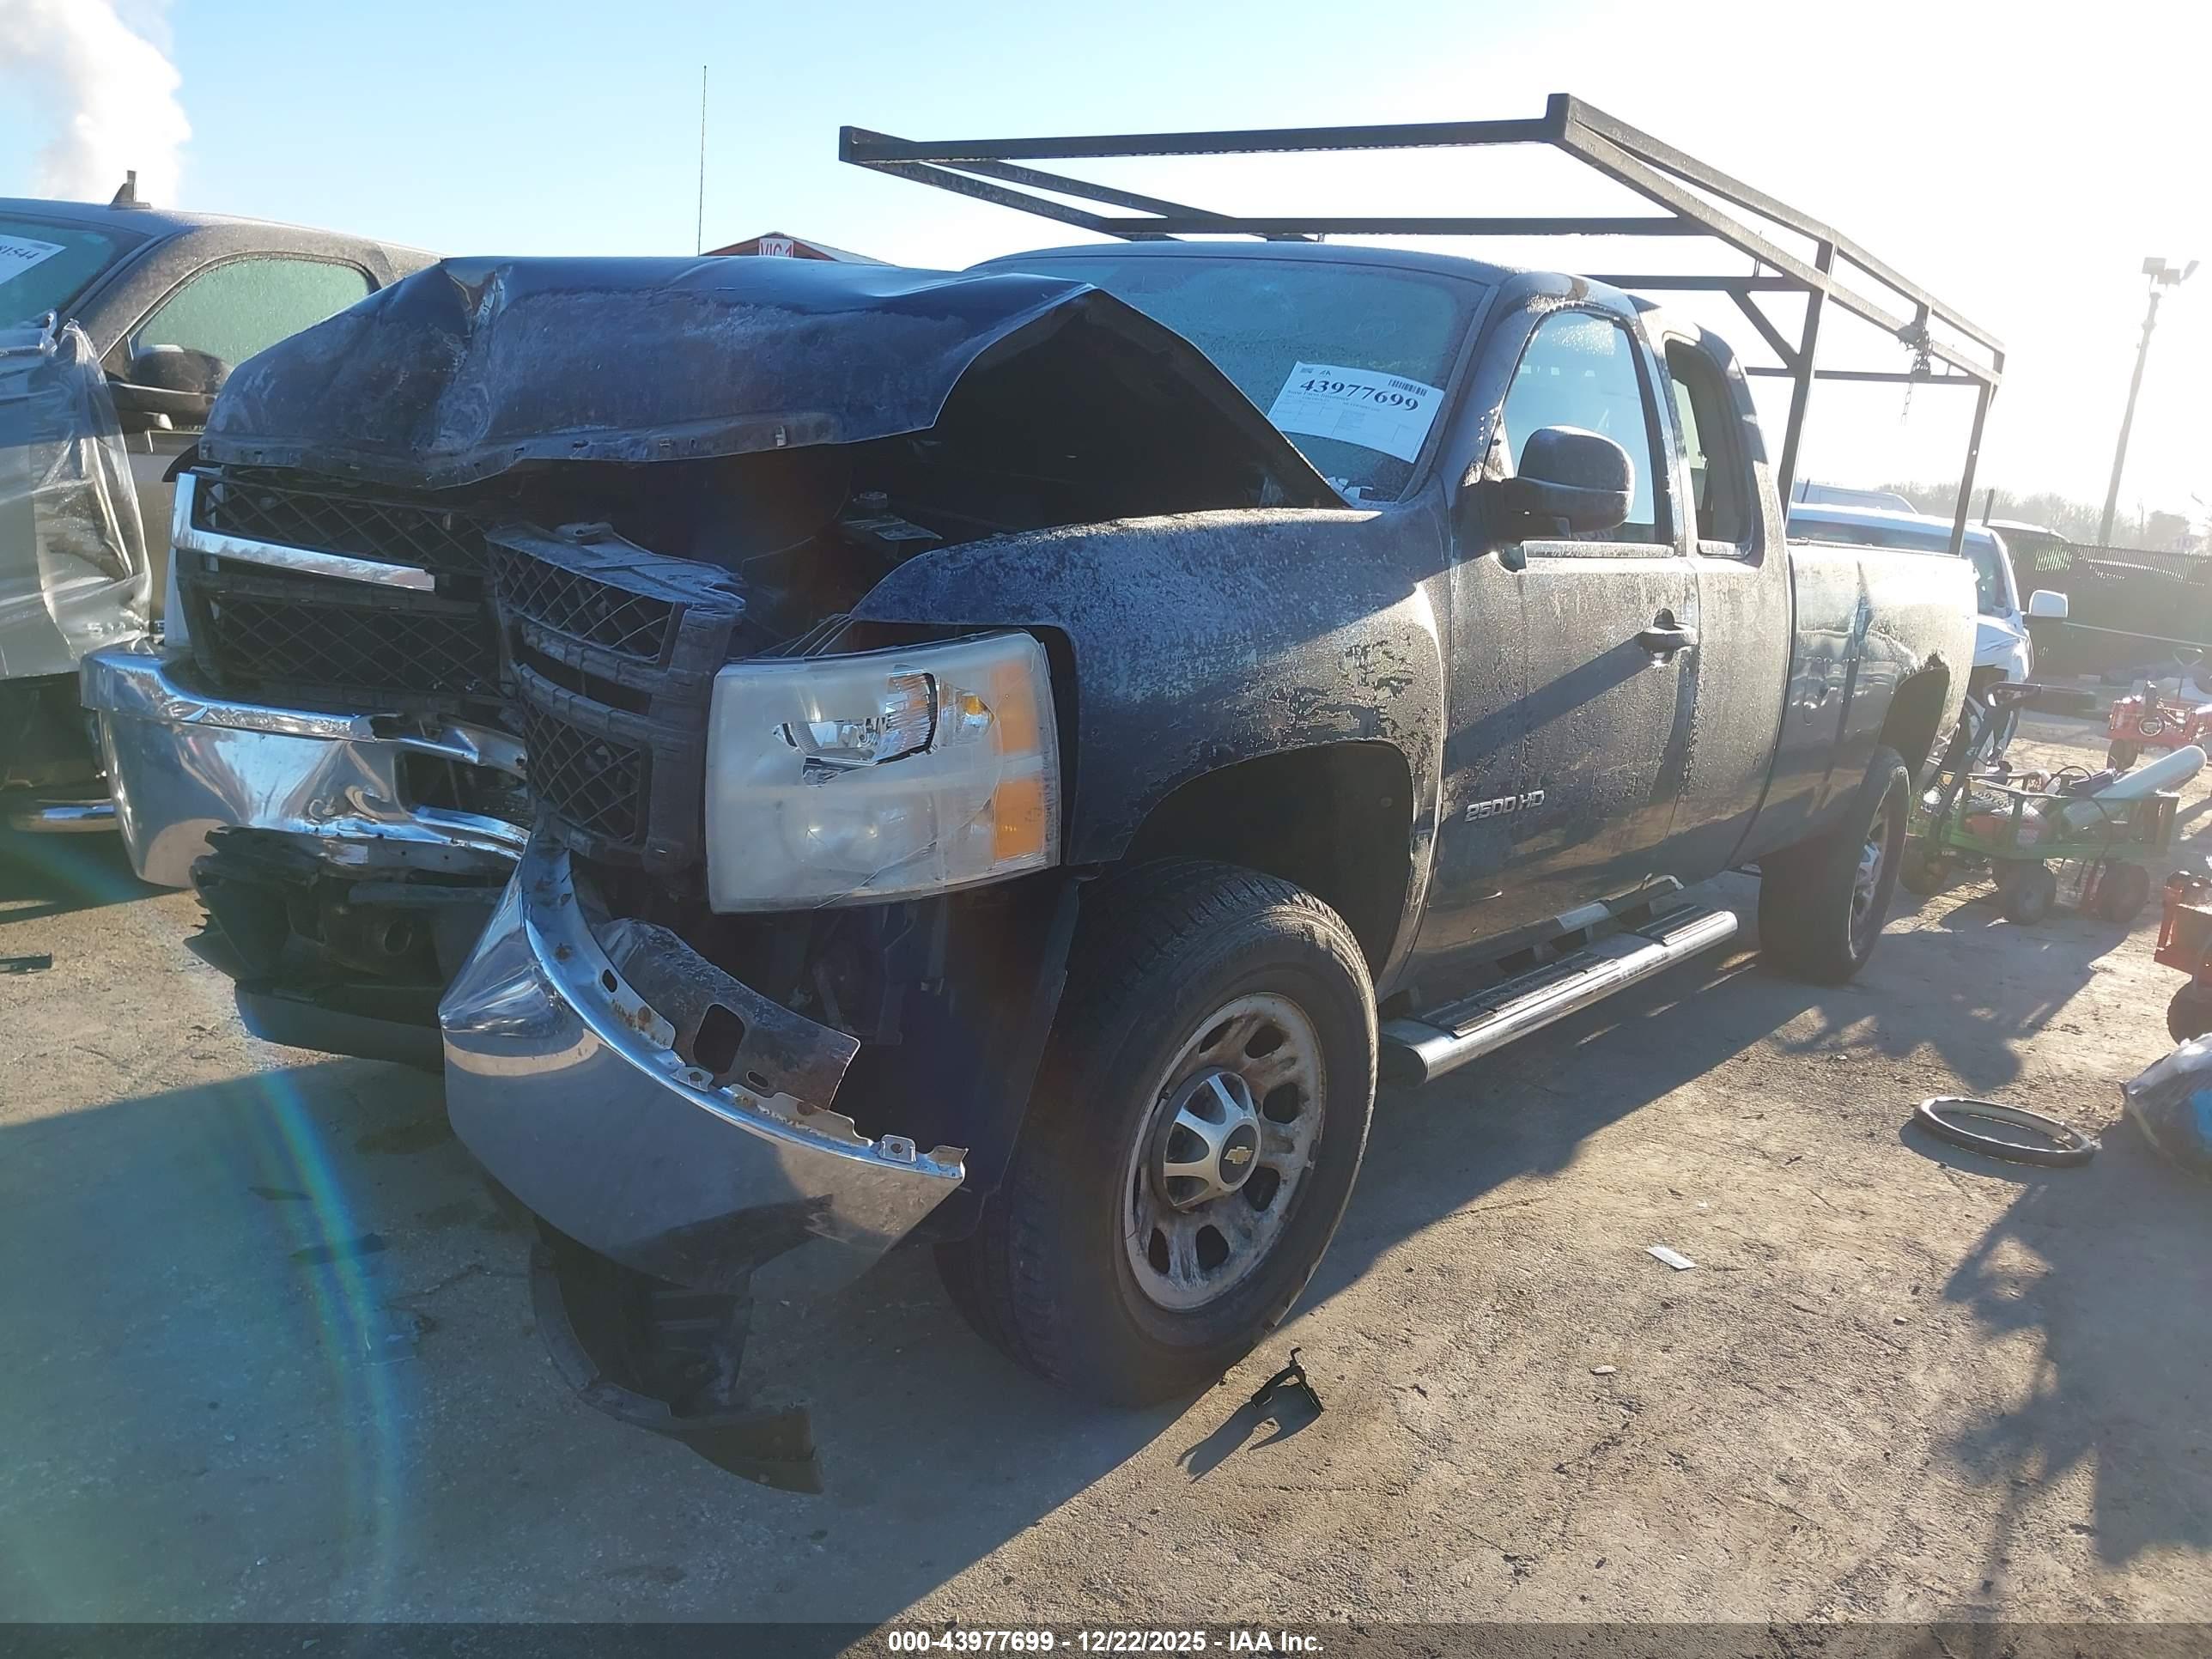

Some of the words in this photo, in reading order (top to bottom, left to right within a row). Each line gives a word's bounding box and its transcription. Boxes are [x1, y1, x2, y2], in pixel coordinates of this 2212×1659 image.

[1299, 379, 1419, 411] 43977699
[1464, 796, 1517, 822] 2500
[1517, 790, 1545, 811] HD
